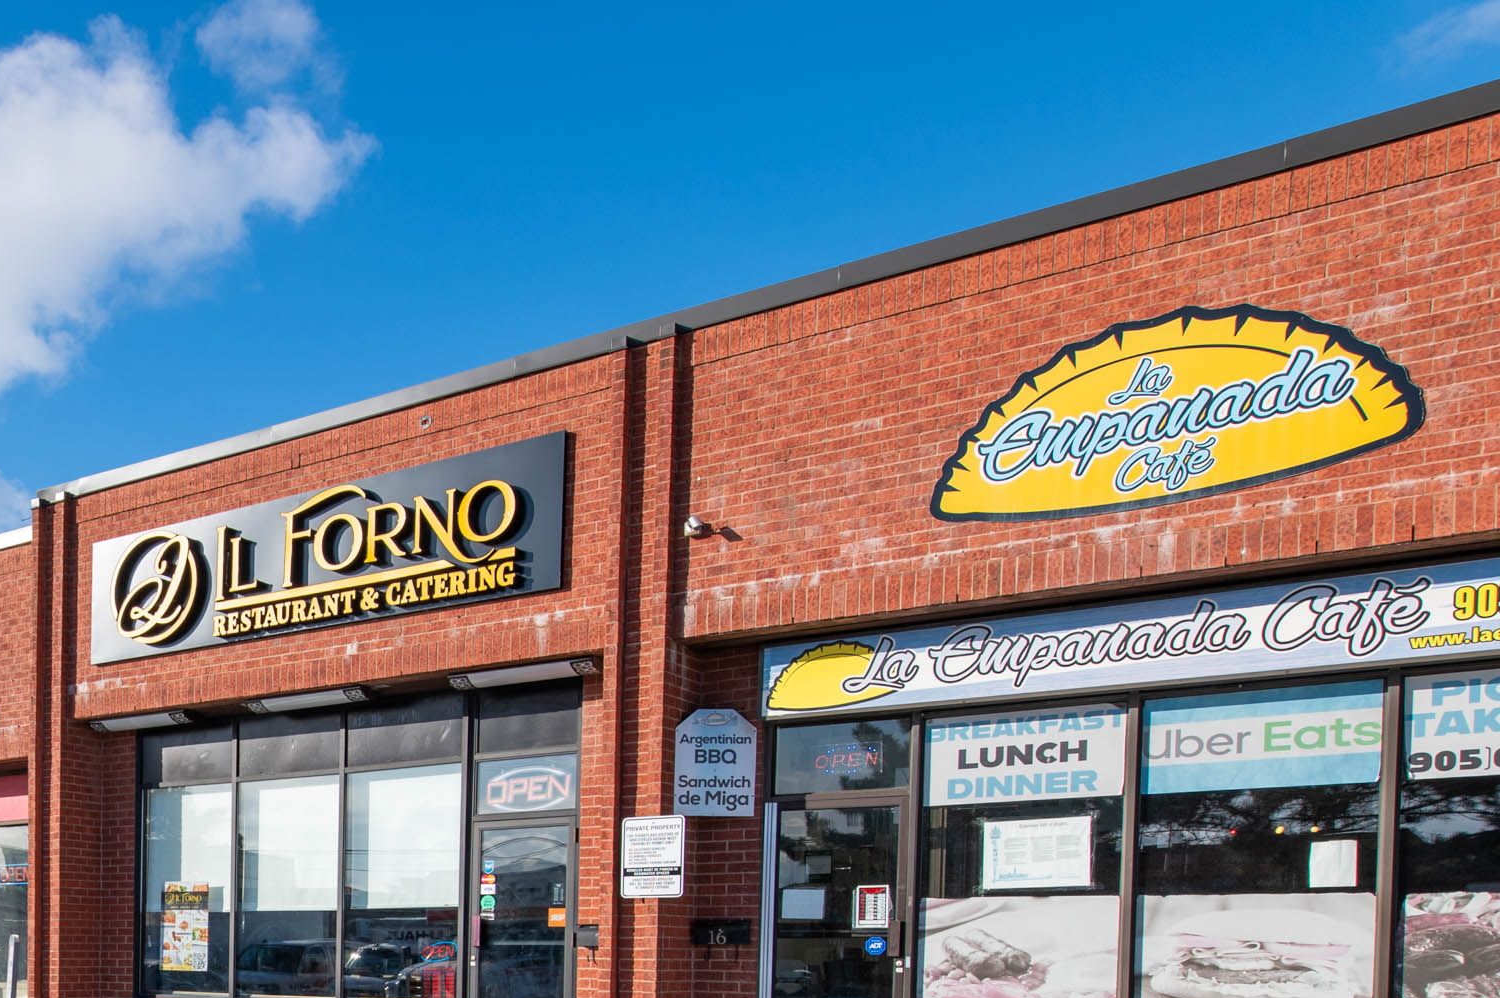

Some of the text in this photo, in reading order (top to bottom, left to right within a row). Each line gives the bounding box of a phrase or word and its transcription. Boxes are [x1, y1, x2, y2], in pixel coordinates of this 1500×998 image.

[1109, 357, 1172, 405] La
[981, 350, 1359, 480] Empanada
[1116, 436, 1216, 493] Café
[216, 479, 517, 601] IL FORNO
[213, 560, 516, 637] RESTAURANT & CATERING
[1453, 583, 1500, 621] 90
[842, 577, 1433, 693] La Empanada Café
[680, 733, 752, 748] Argentinian
[930, 709, 1125, 743] BREAKFAST
[1143, 717, 1381, 760] Uber Eats
[694, 749, 737, 764] BBQ
[814, 751, 879, 769] OPEN
[958, 739, 1088, 770] LUNCH
[486, 773, 571, 805] OPEN
[678, 775, 751, 788] Sandwich
[947, 769, 1098, 800] DINNER
[678, 790, 749, 811] de Miga
[421, 944, 455, 959] OPEN
[708, 929, 727, 945] 16
